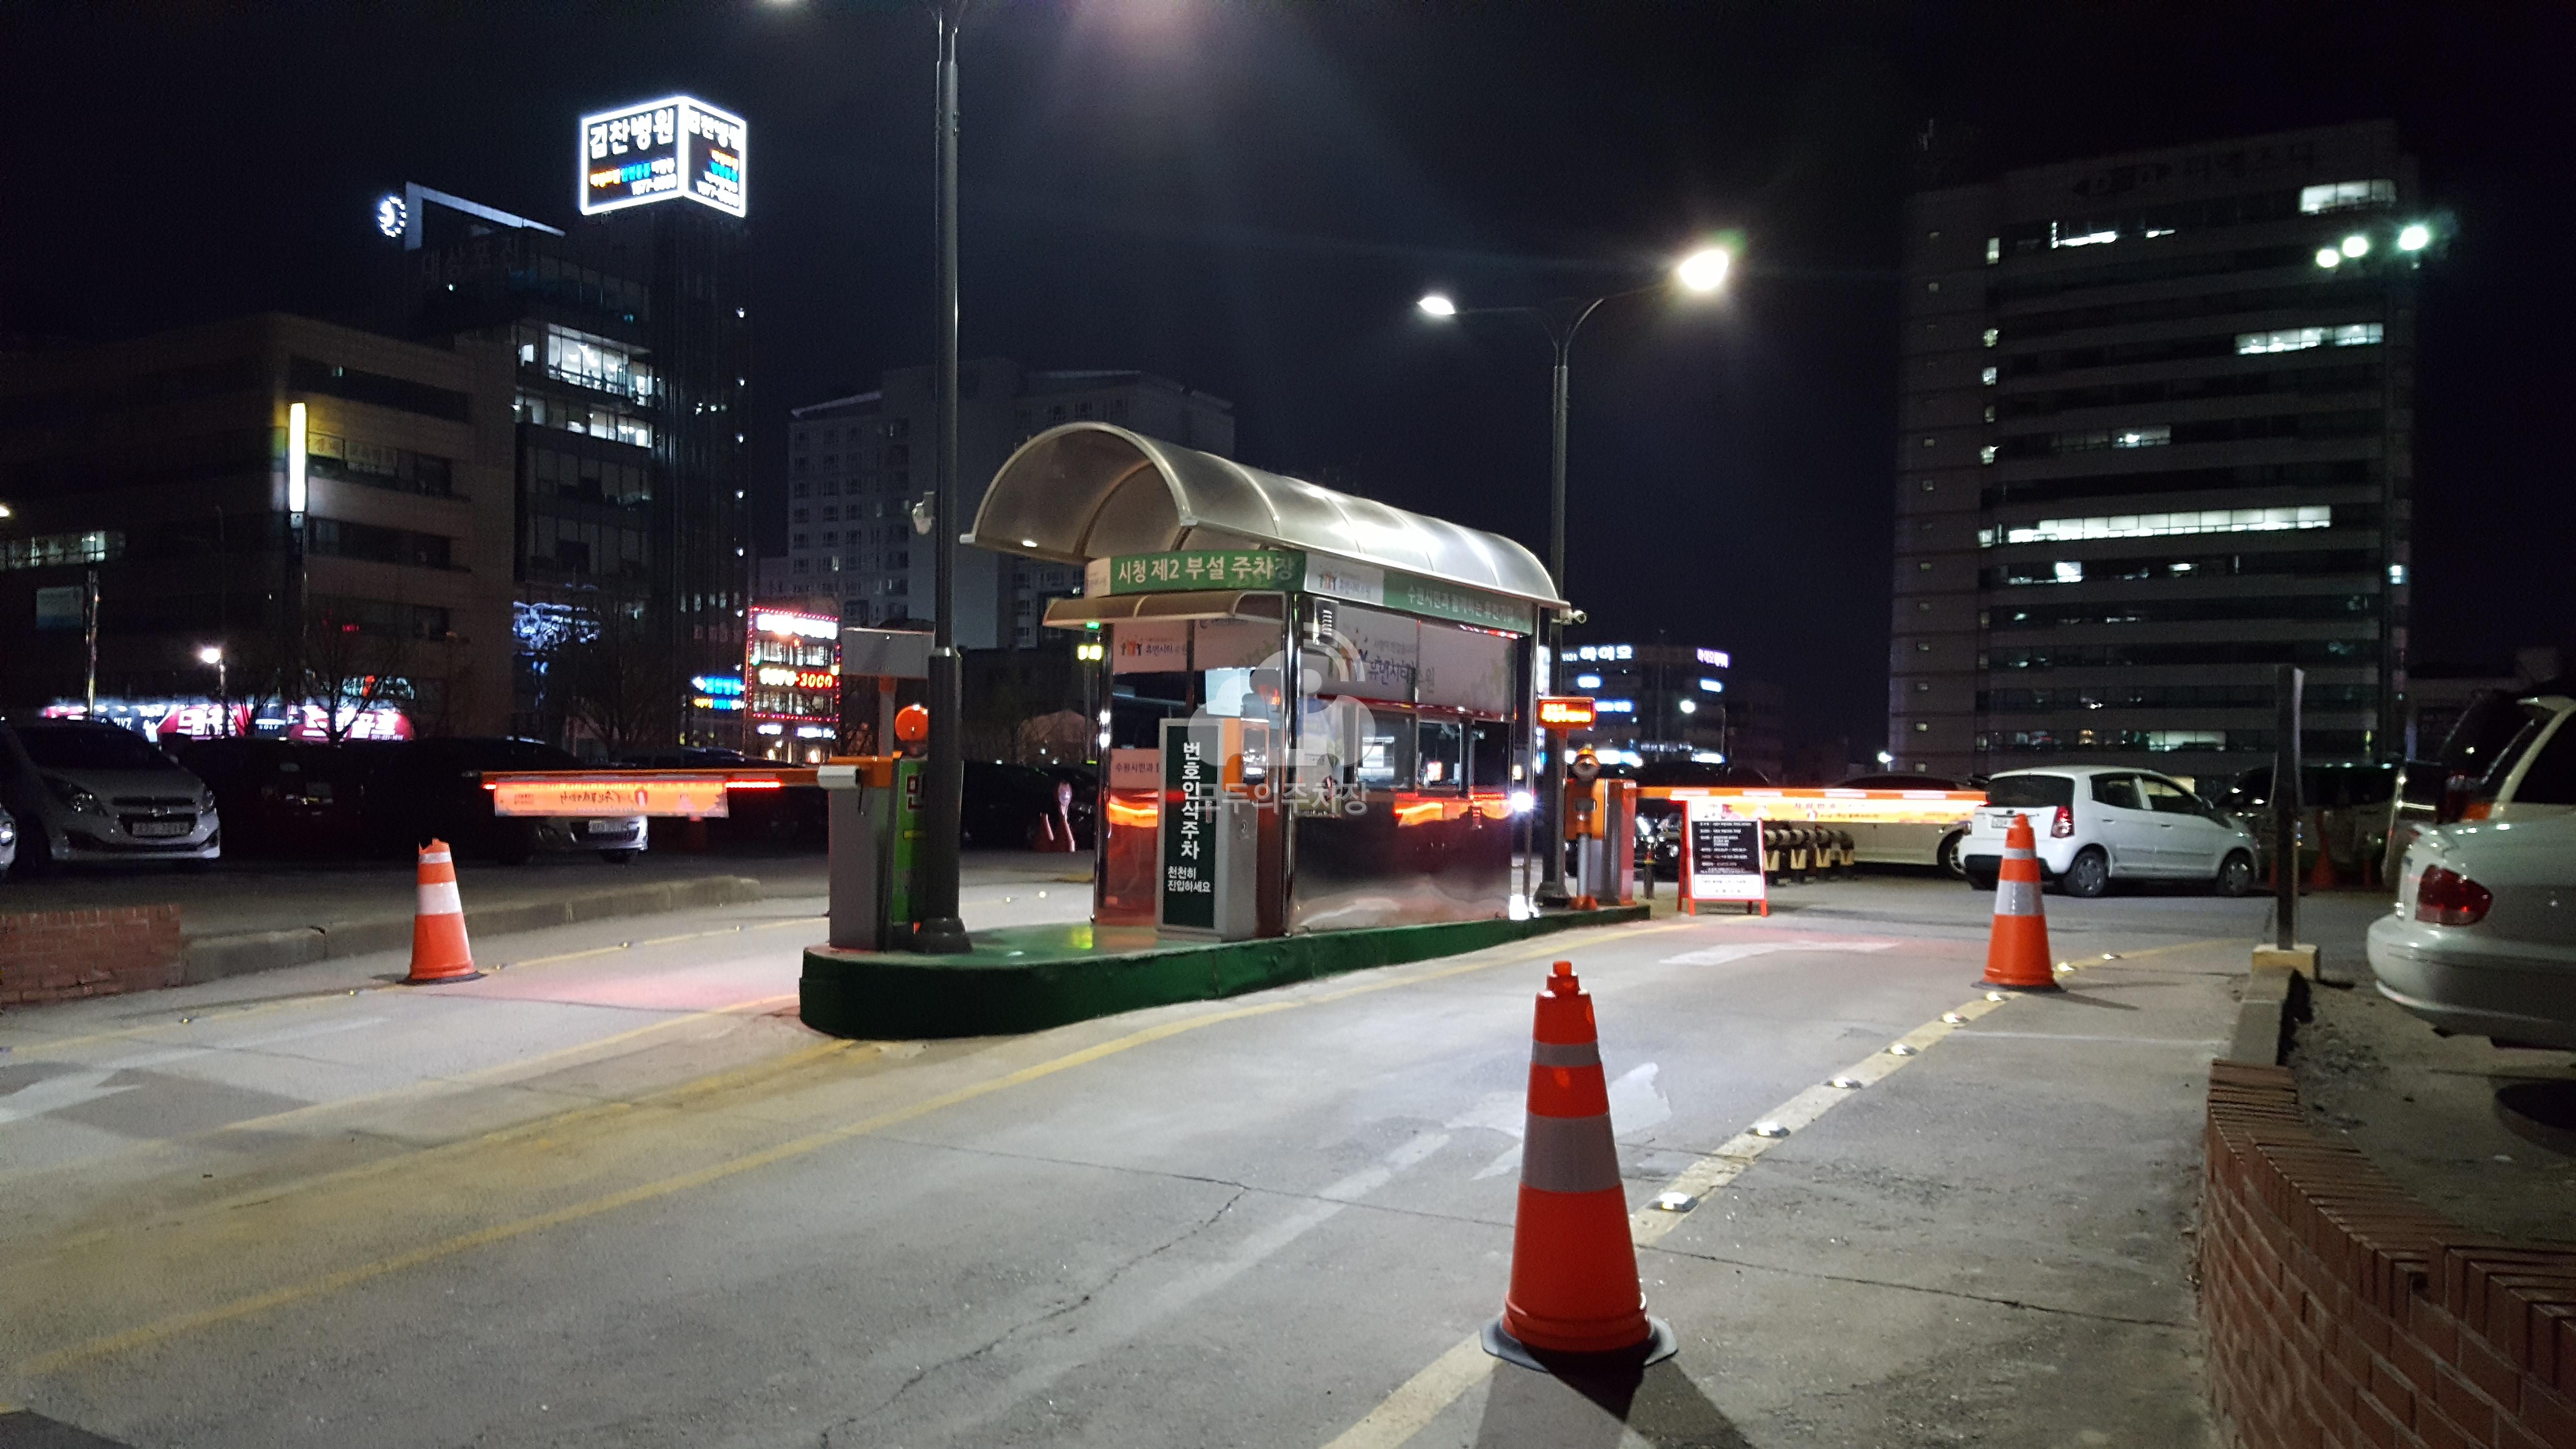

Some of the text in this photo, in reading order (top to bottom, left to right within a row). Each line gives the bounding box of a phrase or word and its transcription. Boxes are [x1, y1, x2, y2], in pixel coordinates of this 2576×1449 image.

[589, 108, 674, 159] 김찬병원
[1119, 556, 1294, 584] 시청 제2 부설 주차장
[1181, 741, 1201, 860] 번호인식주차
[1167, 880, 1211, 893] 진입하세요
[1168, 865, 1197, 880] 천천히
